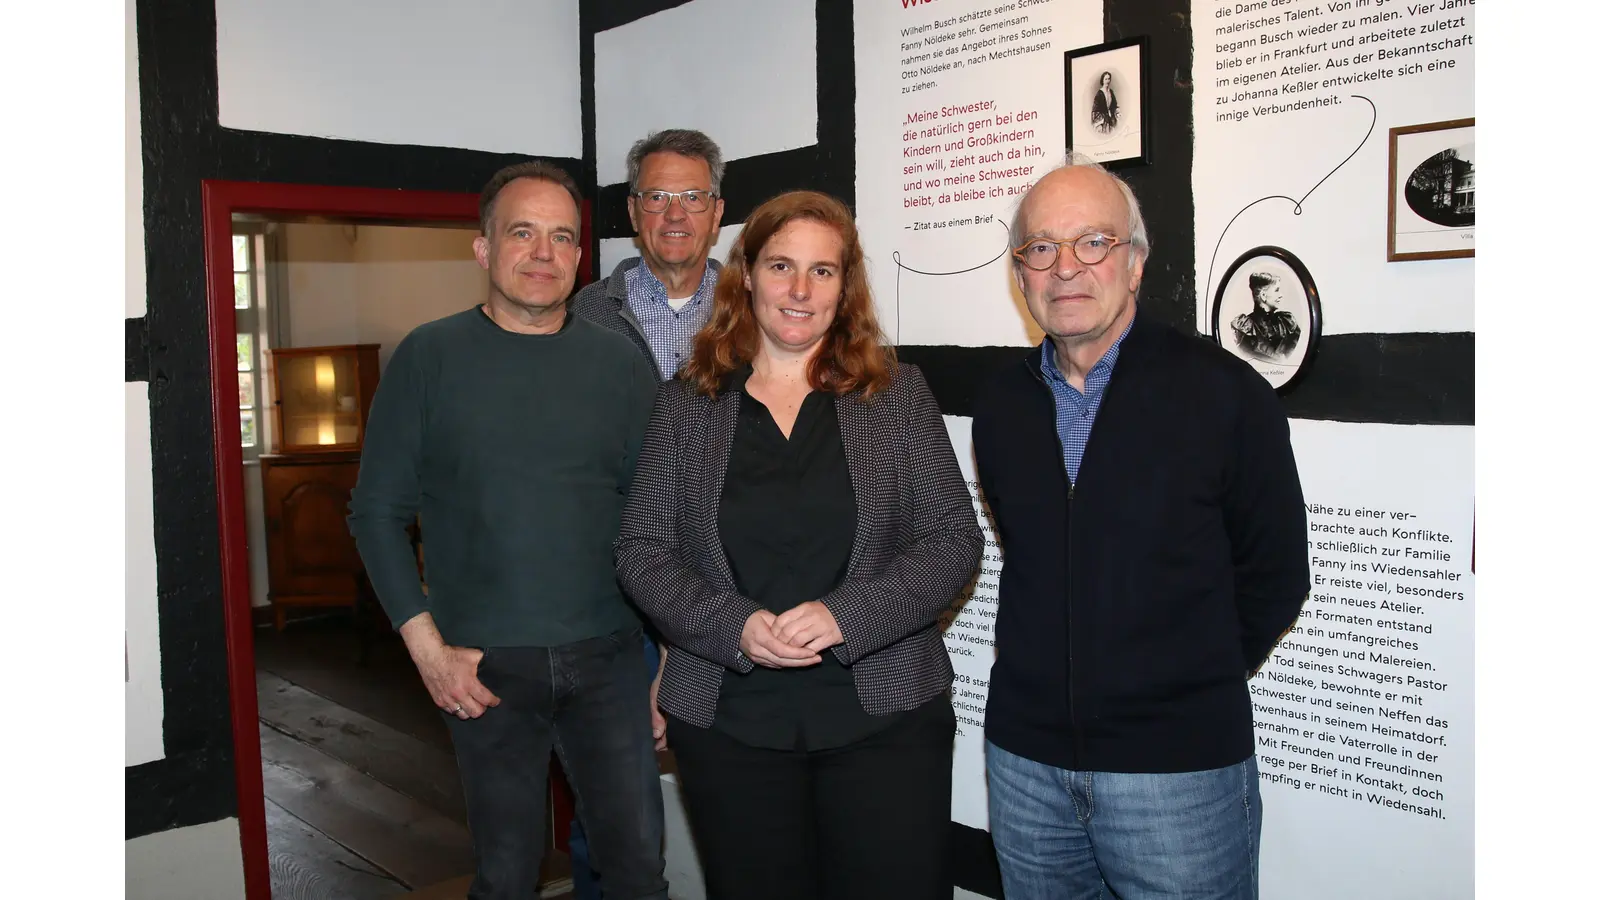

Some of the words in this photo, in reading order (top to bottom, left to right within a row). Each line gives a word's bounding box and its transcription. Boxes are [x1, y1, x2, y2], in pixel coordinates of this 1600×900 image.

[900, 24, 932, 38] Wilhelm
[934, 16, 956, 30] Busch
[958, 10, 992, 24] schätzte
[994, 4, 1016, 14] seine
[1216, 7, 1232, 18] die
[1236, 1, 1268, 14] Dame
[1216, 16, 1280, 36] malerisches
[1284, 6, 1323, 22] Talent.
[1328, 2, 1351, 12] Von
[900, 40, 922, 52] Fanny
[924, 32, 956, 46] Nöldeke
[958, 28, 976, 38] sehr.
[979, 16, 1028, 32] Gemeinsam
[1216, 38, 1256, 53] begann
[1260, 30, 1293, 44] Busch
[1297, 22, 1338, 37] wieder
[1342, 20, 1356, 29] zu
[1360, 12, 1402, 26] malen.
[1407, 4, 1435, 16] Vier
[1216, 58, 1242, 70] blieb
[1246, 56, 1256, 65] er
[1260, 52, 1270, 62] in
[1274, 42, 1327, 60] Frankfurt
[1332, 36, 1354, 50] und
[1358, 27, 1416, 44] arbeitete
[1420, 16, 1466, 34] zuletzt
[902, 54, 930, 66] nahmen
[932, 49, 944, 58] sie
[945, 46, 959, 56] das
[961, 37, 996, 52] Angebot
[998, 33, 1018, 44] ihres
[1021, 26, 1052, 38] Sohnes
[1216, 78, 1230, 87] im
[1233, 70, 1276, 86] eigenen
[1280, 62, 1321, 76] Atelier.
[1326, 58, 1349, 69] Aus
[1352, 53, 1374, 64] der
[1378, 34, 1473, 60] Bekanntschaft
[902, 70, 918, 80] Otto
[920, 62, 951, 76] Nöldeke
[953, 60, 965, 68] an,
[968, 54, 986, 65] nach
[989, 42, 1050, 60] Mechtshausen
[902, 86, 910, 94] zu
[912, 81, 938, 92] ziehen.
[1216, 96, 1228, 104] zu
[1232, 88, 1278, 102] Johanna
[1282, 81, 1318, 94] Keßler
[1322, 68, 1394, 88] entwickelte
[1398, 62, 1422, 76] sich
[1428, 59, 1456, 72] eine
[942, 100, 997, 118] Schwester,
[1216, 110, 1249, 122] innige
[1252, 94, 1342, 116] Verbundenheit.
[902, 130, 918, 142] die
[920, 121, 964, 138] natürlich
[968, 118, 992, 134] gern
[996, 112, 1012, 126] bei
[1016, 110, 1038, 122] den
[904, 144, 942, 158] Kindern
[944, 138, 964, 152] und
[967, 130, 1034, 148] Großkindern
[904, 162, 922, 175] sein
[926, 159, 946, 172] will,
[950, 155, 975, 168] zieht
[978, 150, 1004, 164] auch
[1007, 148, 1020, 160] da
[1024, 144, 1045, 158] hin,
[904, 178, 922, 192] und
[924, 179, 940, 188] wo
[944, 172, 976, 186] meine
[978, 166, 1034, 182] Schwester
[904, 196, 934, 208] bleibt,
[938, 192, 950, 204] da
[954, 188, 986, 202] bleibe
[988, 186, 1004, 198] ich
[914, 222, 931, 230] Zitat
[948, 218, 972, 227] einem
[974, 214, 993, 224] Brief
[1304, 504, 1334, 515] Nähe
[1338, 508, 1350, 516] zu
[1354, 507, 1386, 518] einer
[1310, 522, 1355, 534] brachte
[1359, 527, 1388, 537] auch
[1392, 528, 1452, 542] Konflikte.
[1316, 540, 1377, 554] schließlich
[1382, 548, 1401, 556] zur
[1405, 548, 1450, 562] Familie
[1312, 556, 1346, 572] Fanny
[1350, 560, 1367, 572] ins
[1371, 562, 1462, 581] Wiedensahler
[1315, 574, 1326, 584] Er
[1330, 577, 1362, 590] reiste
[1366, 580, 1391, 594] viel,
[1396, 583, 1464, 600] besonders
[1314, 593, 1336, 604] sein
[1340, 598, 1376, 609] neues
[1380, 600, 1424, 614] Atelier.
[955, 619, 974, 629] doch
[976, 622, 990, 632] viel
[1316, 610, 1372, 626] Formaten
[1376, 620, 1432, 634] entstand
[948, 646, 974, 657] zurück.
[1307, 626, 1324, 637] ein
[1328, 631, 1418, 650] umfangreiches
[1273, 654, 1294, 667] Tod
[1298, 660, 1334, 674] seines
[1338, 665, 1402, 684] Schwagers
[1408, 676, 1448, 691] Pastor
[1343, 650, 1365, 660] und
[1370, 652, 1436, 671] Malereien.
[1268, 670, 1316, 690] Nöldeke,
[1322, 680, 1381, 698] bewohnte
[1385, 692, 1398, 701] er
[1402, 694, 1422, 706] mit
[1250, 684, 1306, 703] Schwester
[1310, 698, 1332, 708] und
[1336, 702, 1374, 715] seinen
[1379, 706, 1421, 724] Neffen
[1426, 716, 1448, 728] das
[1311, 712, 1320, 723] in
[1324, 716, 1367, 732] seinem
[1372, 723, 1446, 746] Heimatdorf.
[1258, 736, 1278, 748] Mit
[1281, 740, 1334, 760] Freunden
[1338, 754, 1360, 766] und
[1365, 757, 1442, 782] Freundinnen
[1302, 730, 1314, 738] er
[1318, 732, 1336, 743] die
[1339, 734, 1398, 755] Vaterrolle
[1402, 746, 1412, 758] in
[1416, 750, 1438, 763] der
[1260, 756, 1285, 768] rege
[1288, 761, 1308, 771] per
[1311, 764, 1338, 778] Brief
[1342, 770, 1352, 781] in
[1356, 772, 1408, 795] Kontakt,
[1412, 786, 1444, 801] doch
[1304, 782, 1316, 790] er
[1320, 784, 1348, 798] nicht
[1352, 789, 1362, 800] in
[1366, 792, 1446, 820] Wiedensahl.
